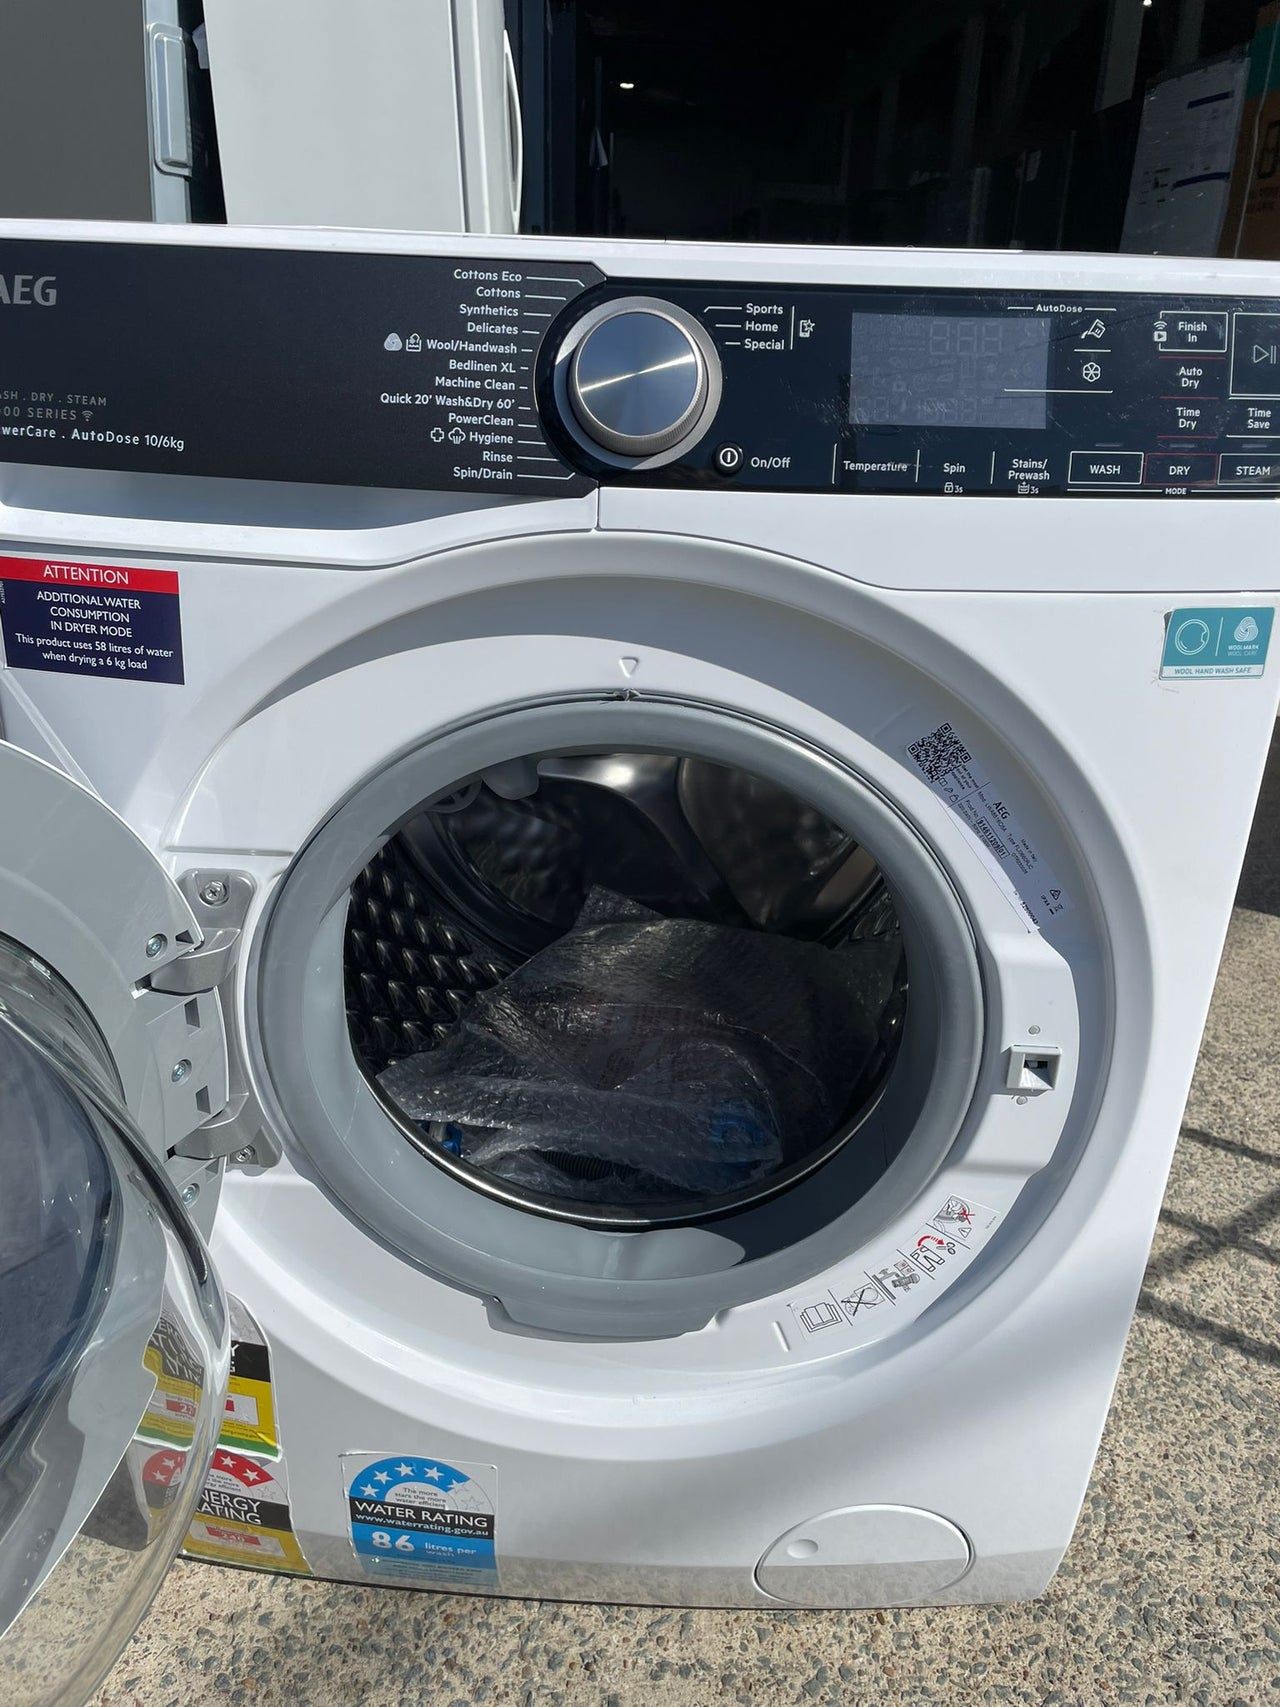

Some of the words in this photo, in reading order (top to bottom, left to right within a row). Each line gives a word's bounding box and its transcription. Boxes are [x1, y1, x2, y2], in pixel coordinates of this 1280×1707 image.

[454, 269, 498, 281] Cottons
[502, 271, 522, 282] Eco
[476, 287, 520, 298] Cottons
[460, 304, 518, 317] Synthetics
[746, 303, 783, 316] Sports
[1036, 304, 1083, 313] AutoDose
[467, 322, 518, 334] Delicates
[746, 321, 778, 332] Home
[1178, 322, 1207, 332] Finish
[744, 338, 784, 351] Special
[1188, 333, 1198, 343] In
[427, 339, 517, 354] Wool/Handwash
[449, 360, 498, 372] Bedlinen
[500, 363, 516, 373] XL
[1179, 366, 1203, 376] Auto
[435, 376, 481, 389] Machine
[484, 379, 515, 391] Clean
[1182, 378, 1200, 389] Dry
[0, 390, 18, 400] SH
[31, 392, 54, 402] DRY
[67, 394, 107, 406] STEAM
[380, 393, 412, 406] Quick
[436, 396, 493, 410] Wash&Dry
[0, 406, 20, 417] 00
[27, 407, 77, 420] SERIES
[1176, 408, 1201, 417] Time
[1248, 408, 1272, 418] Time
[449, 413, 514, 426] PowerClean
[1179, 419, 1197, 430] Dry
[1247, 419, 1270, 429] Save
[2, 425, 56, 438] werCare
[71, 428, 140, 445] AutoDose
[144, 434, 185, 452] 10/6kg
[469, 432, 514, 444] Hygiene
[483, 451, 513, 462] Rinse
[750, 456, 791, 469] On/Off
[843, 460, 908, 474] Temperature
[943, 462, 966, 475] Spin
[1012, 458, 1048, 470] Stains/
[1090, 464, 1121, 475] WASH
[453, 467, 513, 480] Spin/Drain
[1008, 471, 1050, 481] Prewash
[1169, 466, 1191, 476] DRY
[1236, 466, 1271, 476] STEAM
[954, 485, 964, 494] 3s
[1030, 486, 1039, 495] 3s
[43, 564, 129, 585] ATTENTION
[36, 591, 103, 606] ADDITIONAL
[104, 597, 142, 610] WATER
[50, 606, 130, 623] CONSUMPTION
[50, 621, 62, 631] IN
[65, 622, 98, 634] DRYER
[100, 626, 133, 638] MODE
[15, 633, 34, 644] This
[36, 636, 71, 648] product
[73, 640, 92, 650] uses
[95, 641, 107, 651] 58
[108, 643, 132, 654] litres
[134, 645, 144, 655] of
[147, 648, 174, 658] water
[42, 651, 66, 662] when
[68, 654, 97, 667] drying
[99, 658, 104, 666] a
[106, 657, 112, 666] 6
[114, 658, 126, 670] kg
[128, 660, 148, 670] load
[1235, 666, 1252, 674] SAFE
[992, 801, 1011, 820] AEG
[202, 1489, 261, 1513] NERGY
[197, 1502, 262, 1525] ATING
[355, 1500, 416, 1520] WATER
[421, 1511, 488, 1528] RATING
[356, 1514, 489, 1536] www.waterrating.gov.au
[372, 1531, 415, 1552] 86
[424, 1542, 453, 1552] litres
[457, 1547, 477, 1555] per
